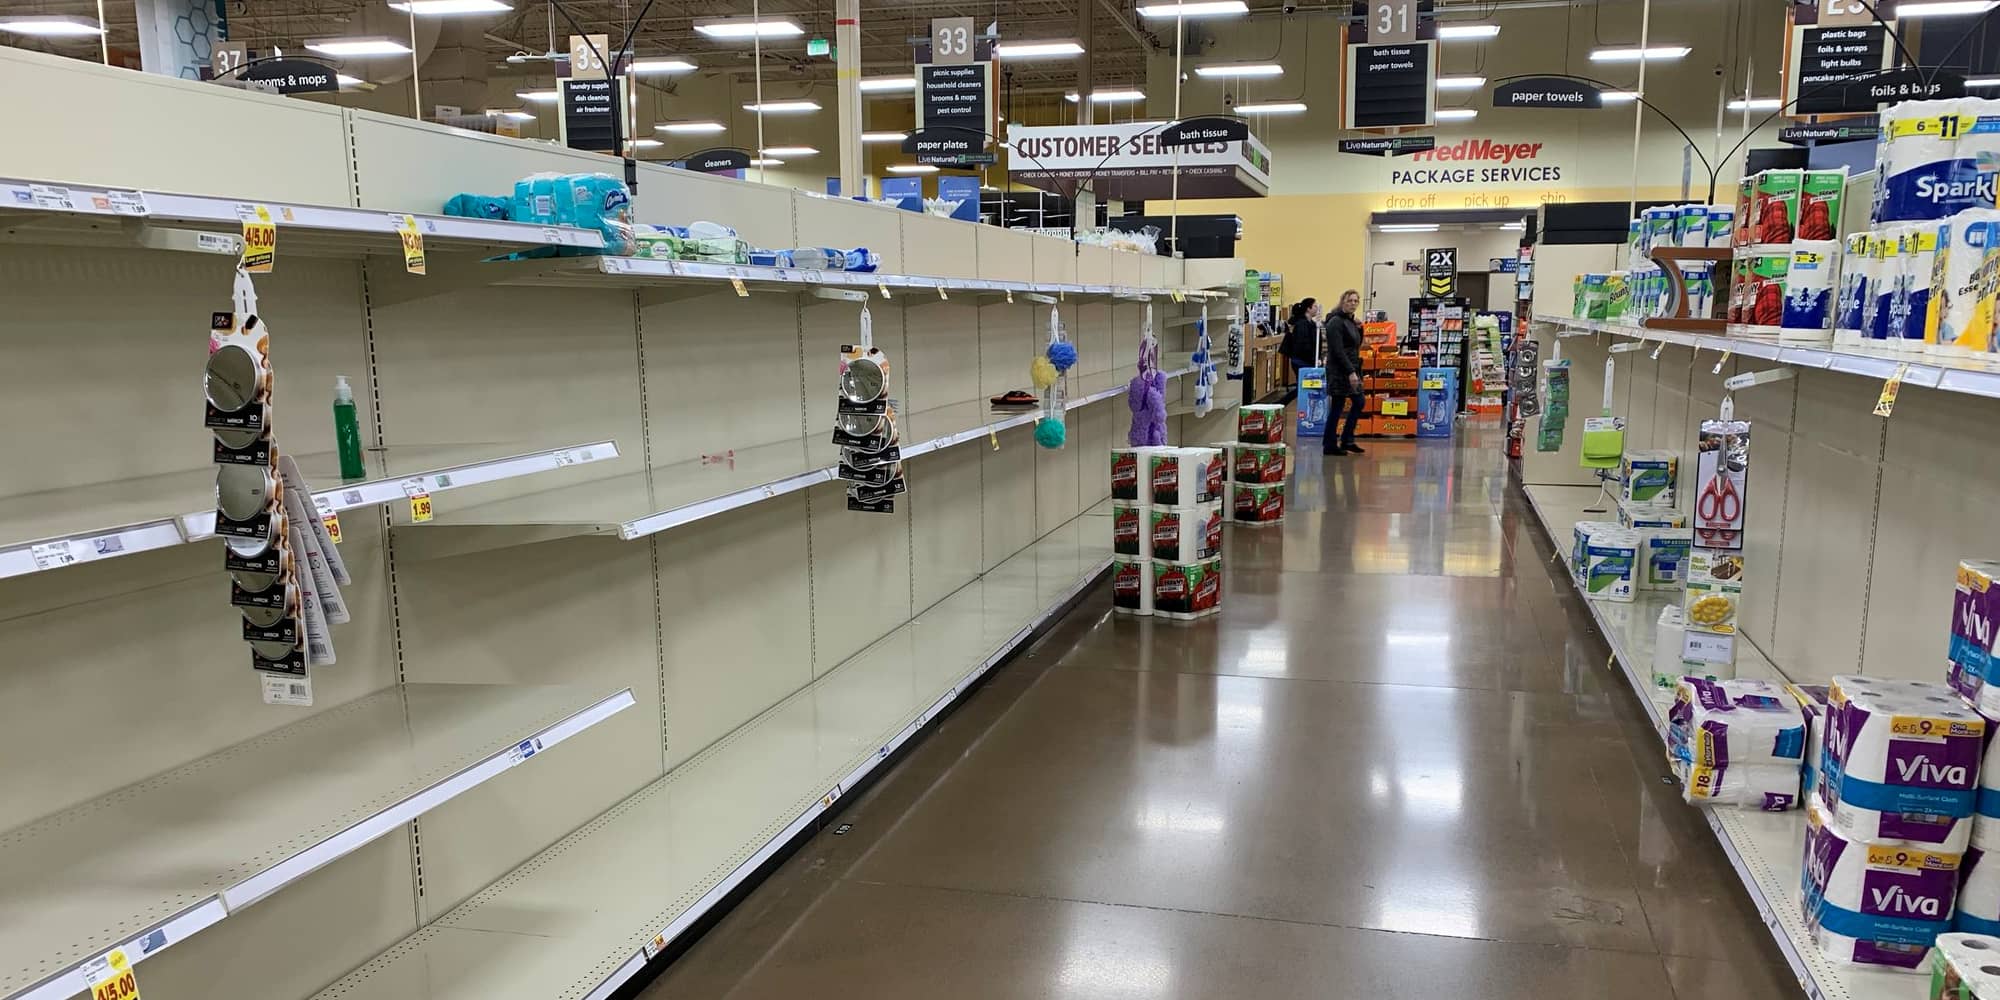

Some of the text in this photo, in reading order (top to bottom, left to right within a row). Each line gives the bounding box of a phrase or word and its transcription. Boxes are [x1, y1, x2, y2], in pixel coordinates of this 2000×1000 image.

[1377, 4, 1408, 34] 31
[1821, 30, 1867, 40] plastic bags
[938, 27, 967, 56] 33
[1373, 48, 1411, 57] bath tissue
[1817, 45, 1868, 54] foils & wraps
[217, 50, 241, 76] 37
[575, 43, 603, 71] 35
[1369, 61, 1414, 72] paper towels
[1820, 59, 1862, 69] light bulbs
[932, 68, 974, 77] picnic supplies
[288, 75, 296, 86] &
[298, 75, 327, 88] mops
[926, 81, 957, 89] household
[1802, 74, 1834, 84] pancake
[569, 83, 590, 91] laundry
[1870, 85, 1896, 97] foils
[1899, 84, 1909, 94] &
[587, 94, 610, 102] cleaning
[960, 95, 977, 103] mops
[1511, 91, 1584, 103] paper towels
[936, 106, 972, 115] pest control
[1916, 121, 1926, 132] 6
[1939, 116, 1960, 137] 11
[1180, 128, 1228, 140] bath tissue
[1803, 129, 1839, 138] Naturally
[917, 140, 968, 151] paper plates
[1018, 135, 1121, 158] CUSTOMER
[1360, 141, 1393, 149] Naturally
[704, 159, 732, 168] cleaners
[1392, 166, 1561, 185] PACKAGE SERVICES
[1386, 193, 1437, 209] drop off
[1464, 192, 1510, 209] pick up
[245, 227, 275, 248] 4/5.00
[1430, 252, 1454, 266] 2X
[1808, 254, 1817, 263] 3
[413, 502, 430, 515] 1.99
[1892, 723, 1901, 734] 6
[1920, 720, 1933, 735] 9
[1895, 754, 1967, 785] Viva
[1895, 852, 1908, 866] 9
[1871, 885, 1940, 916] Viva
